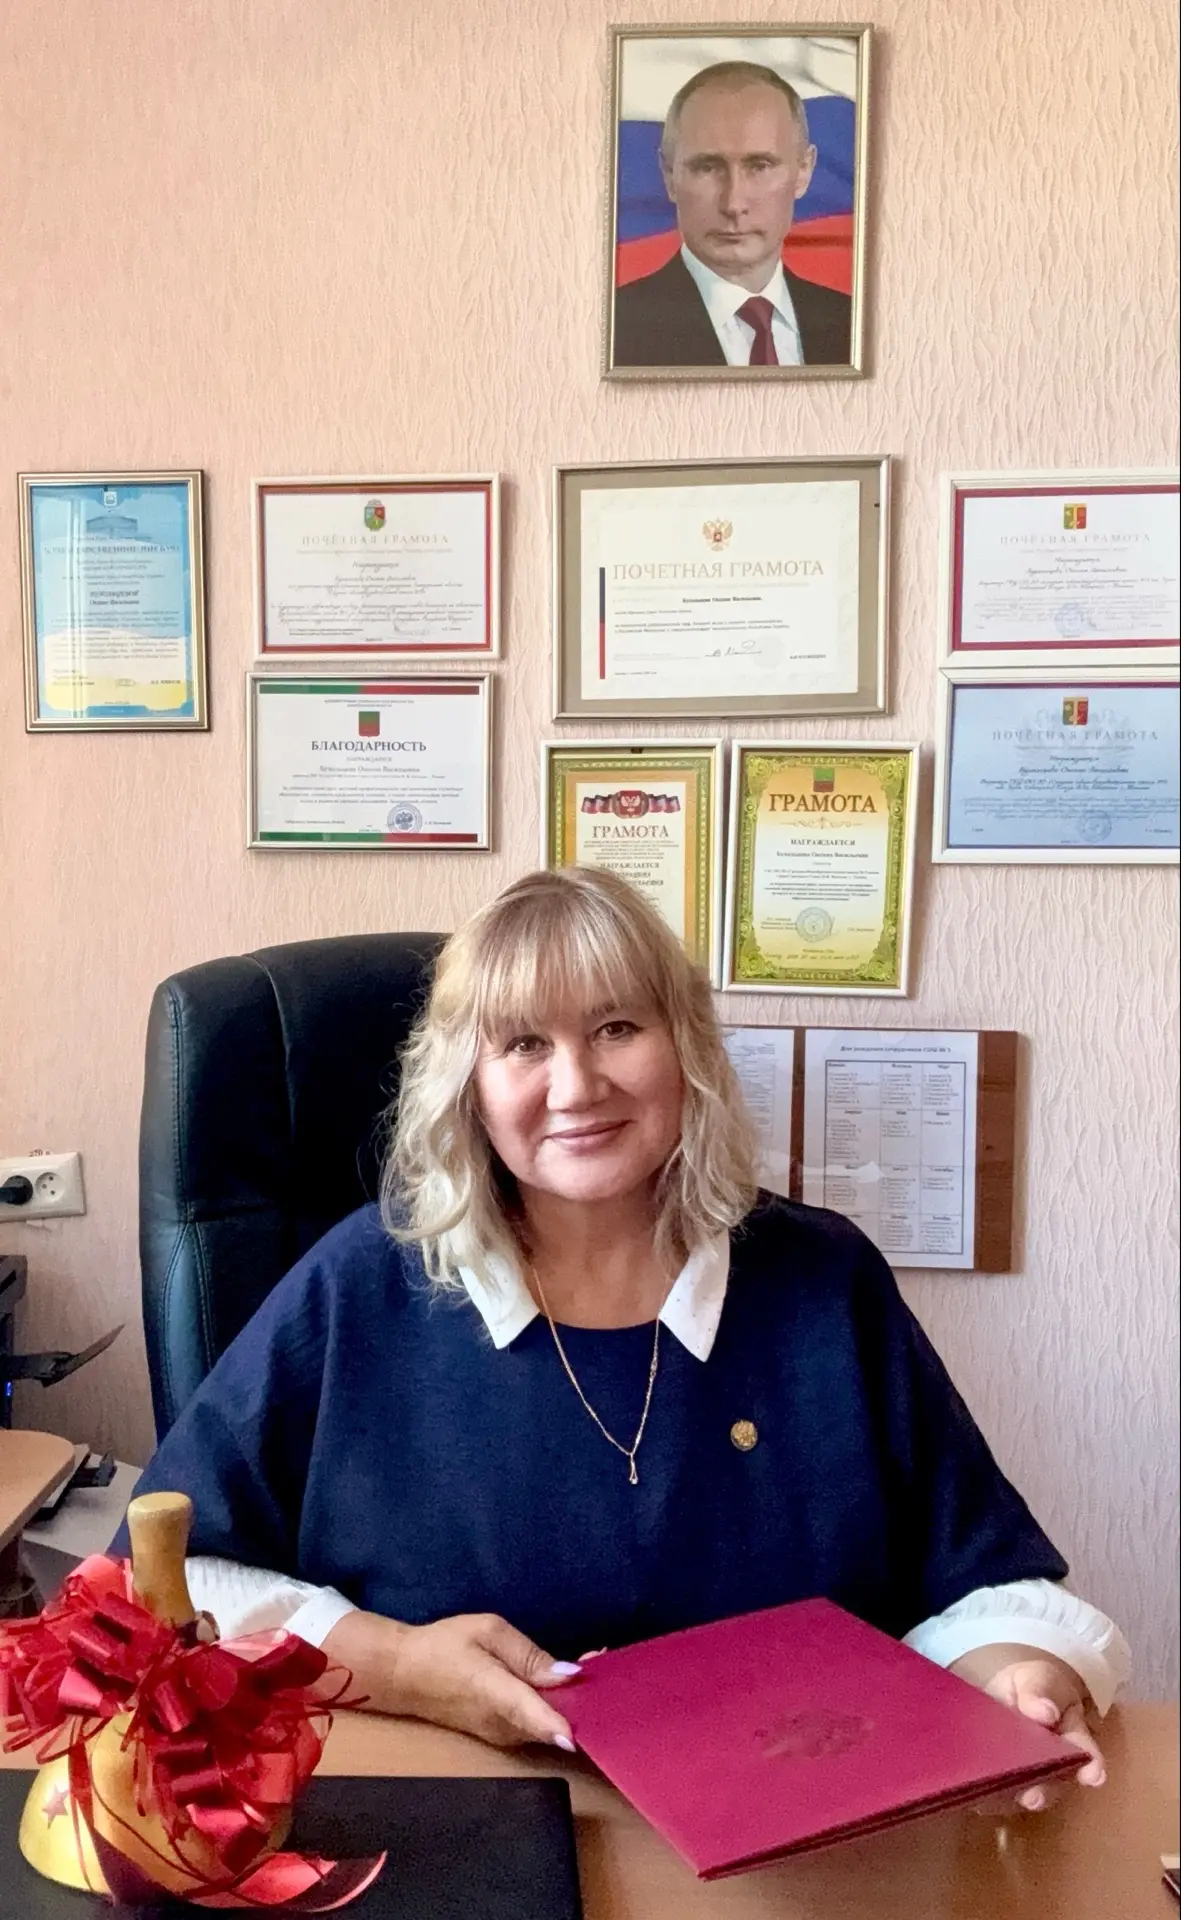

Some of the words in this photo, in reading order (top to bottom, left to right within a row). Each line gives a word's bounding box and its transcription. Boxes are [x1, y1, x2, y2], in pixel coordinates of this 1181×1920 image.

[384, 533, 449, 545] ГРАМОТА
[1084, 533, 1151, 543] ГРАМОТА
[612, 562, 723, 580] ПОЧЕТНАЯ
[730, 559, 824, 578] ГРАМОТА
[1085, 730, 1159, 741] ГРАМОТА
[311, 740, 427, 752] БЛАГОДАРНОСТЬ
[768, 793, 878, 814] ГРАМОТА
[592, 825, 669, 838] ГРАМОТА
[790, 838, 856, 846] НАГРАЖДАЕТСЯ
